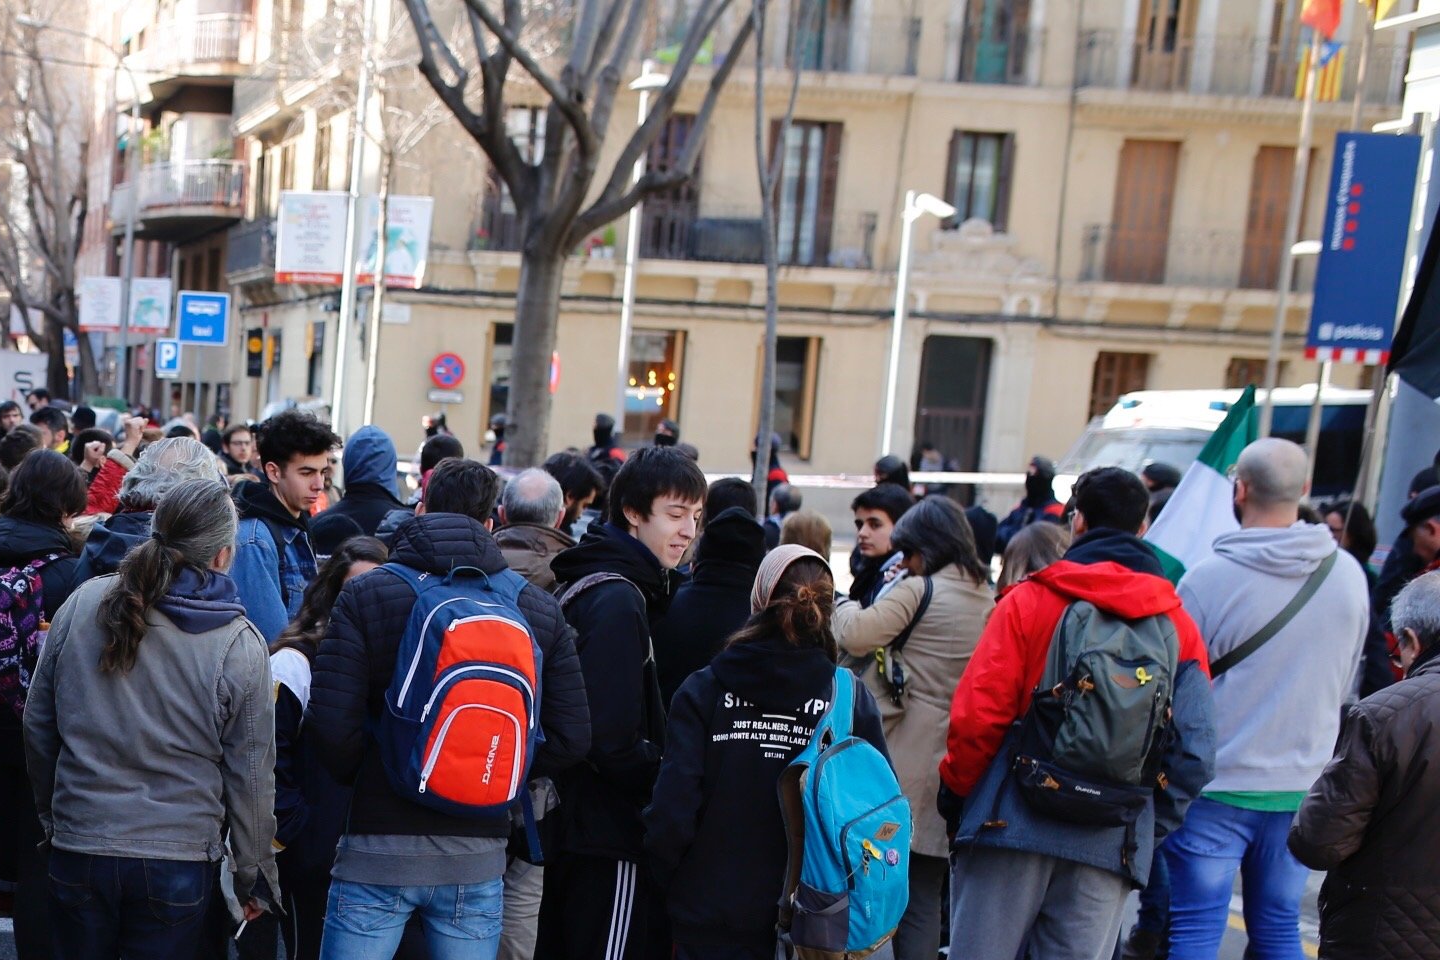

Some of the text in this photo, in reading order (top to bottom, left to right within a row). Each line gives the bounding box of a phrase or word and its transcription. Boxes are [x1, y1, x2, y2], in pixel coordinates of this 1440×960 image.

[161, 344, 177, 368] P
[733, 721, 751, 729] JUST
[752, 721, 791, 733] REALNESS,
[792, 725, 804, 735] NO
[750, 732, 767, 740] ALTO
[769, 733, 789, 743] SILVER
[788, 736, 807, 746] LAKE
